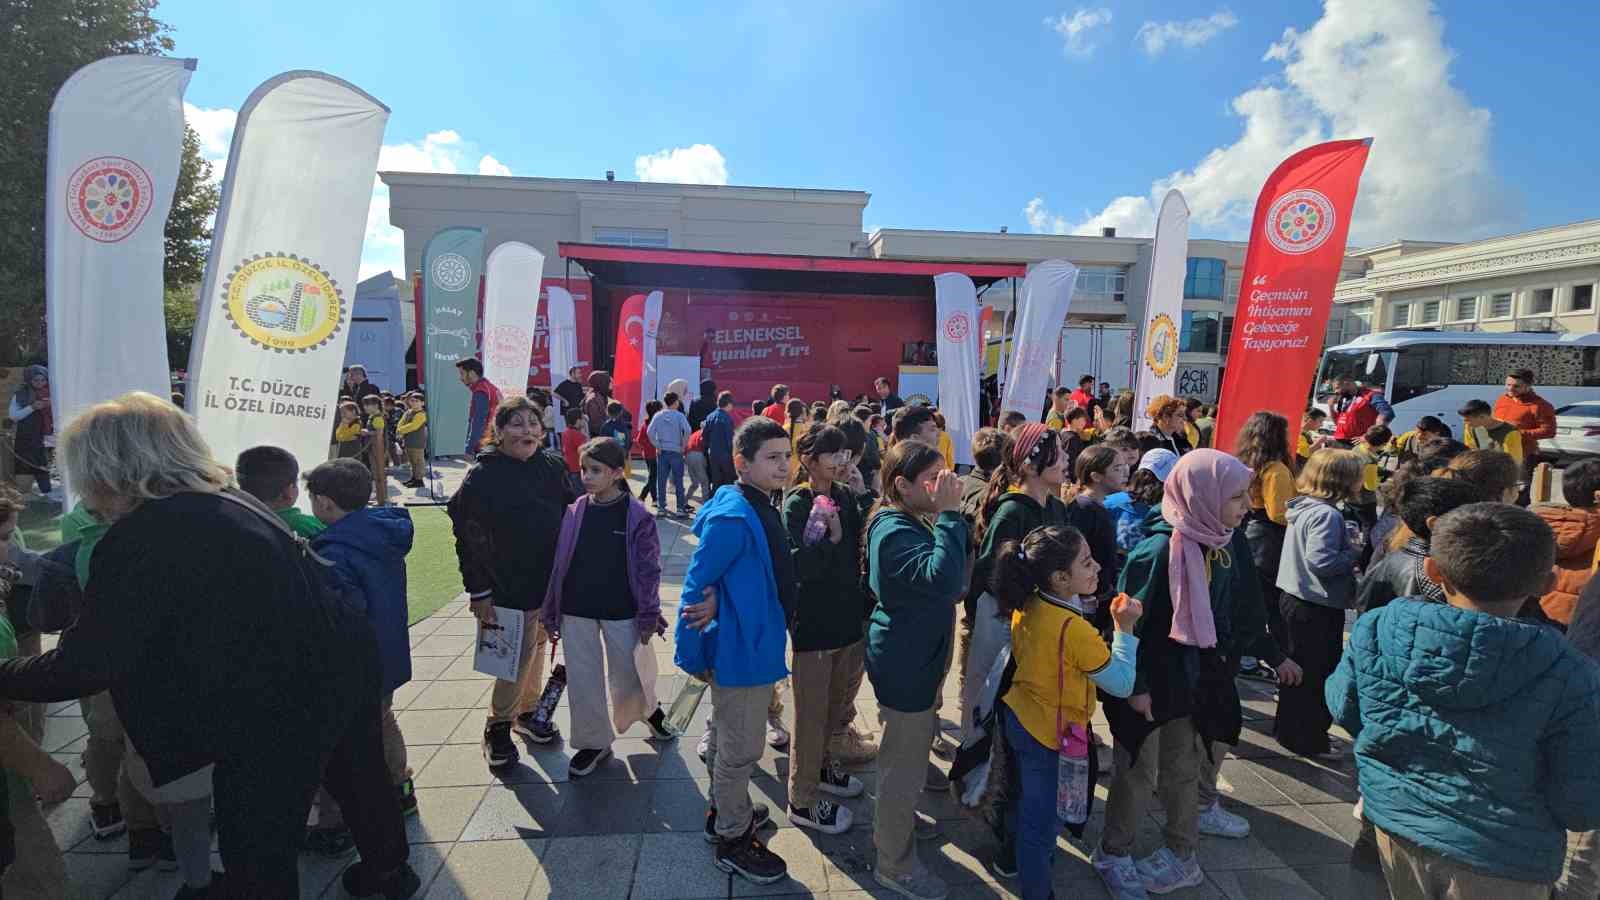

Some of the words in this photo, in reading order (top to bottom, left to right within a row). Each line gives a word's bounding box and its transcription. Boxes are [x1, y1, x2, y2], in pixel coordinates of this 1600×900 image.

[1250, 288, 1309, 304] Geçmişin
[1243, 320, 1300, 336] Geleceğe
[1241, 336, 1310, 352] Taşıyoruz!
[711, 343, 772, 365] yunlar
[229, 376, 255, 392] T.C.
[261, 379, 311, 399] DÜZCE
[204, 390, 219, 409] İL
[224, 393, 265, 413] ÖZEL
[270, 398, 328, 420] İDARESİ
